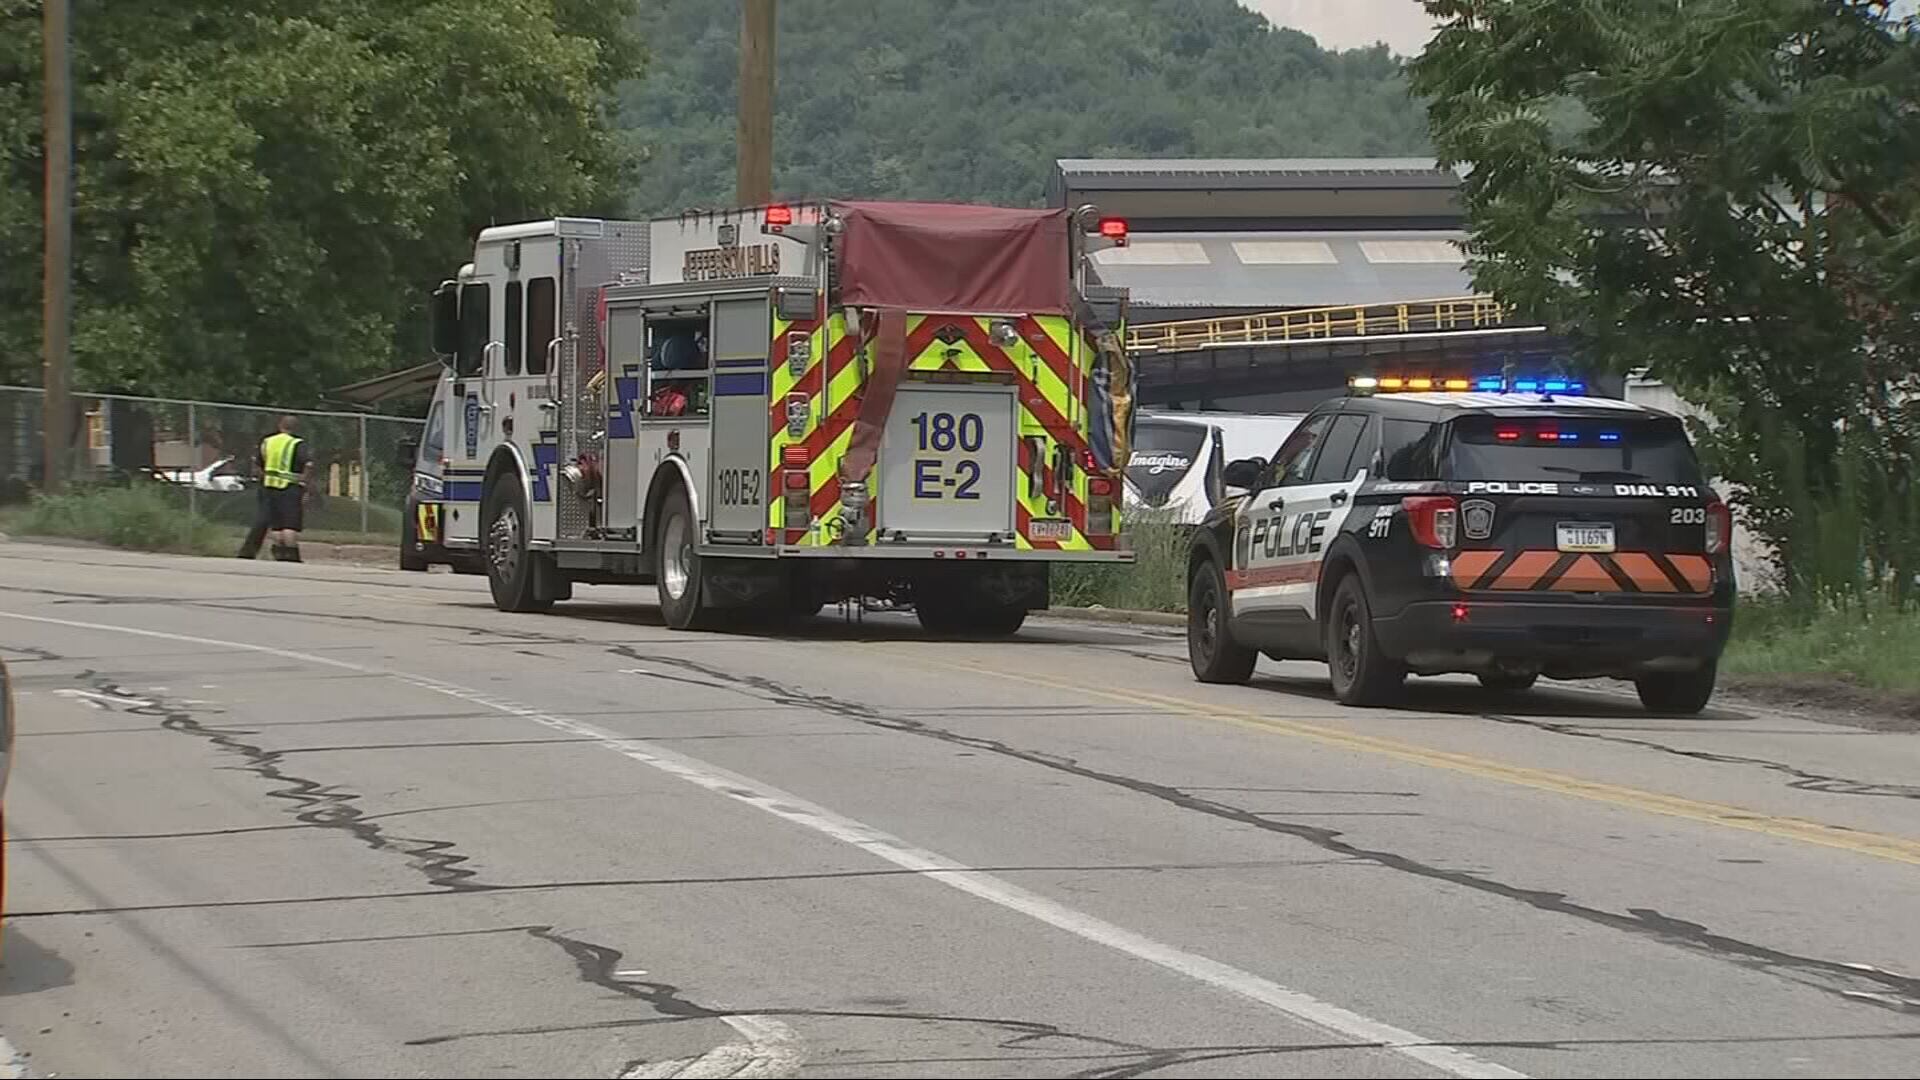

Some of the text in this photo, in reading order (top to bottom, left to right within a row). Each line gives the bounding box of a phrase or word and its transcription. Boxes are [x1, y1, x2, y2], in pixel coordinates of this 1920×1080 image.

[910, 412, 984, 452] 180
[1128, 451, 1191, 474] Imagine
[914, 459, 981, 499] E-2
[1469, 482, 1698, 497] POLICE DIAL 911
[1368, 518, 1391, 538] 911
[1670, 508, 1706, 525] 203
[1250, 511, 1332, 561] POLICE
